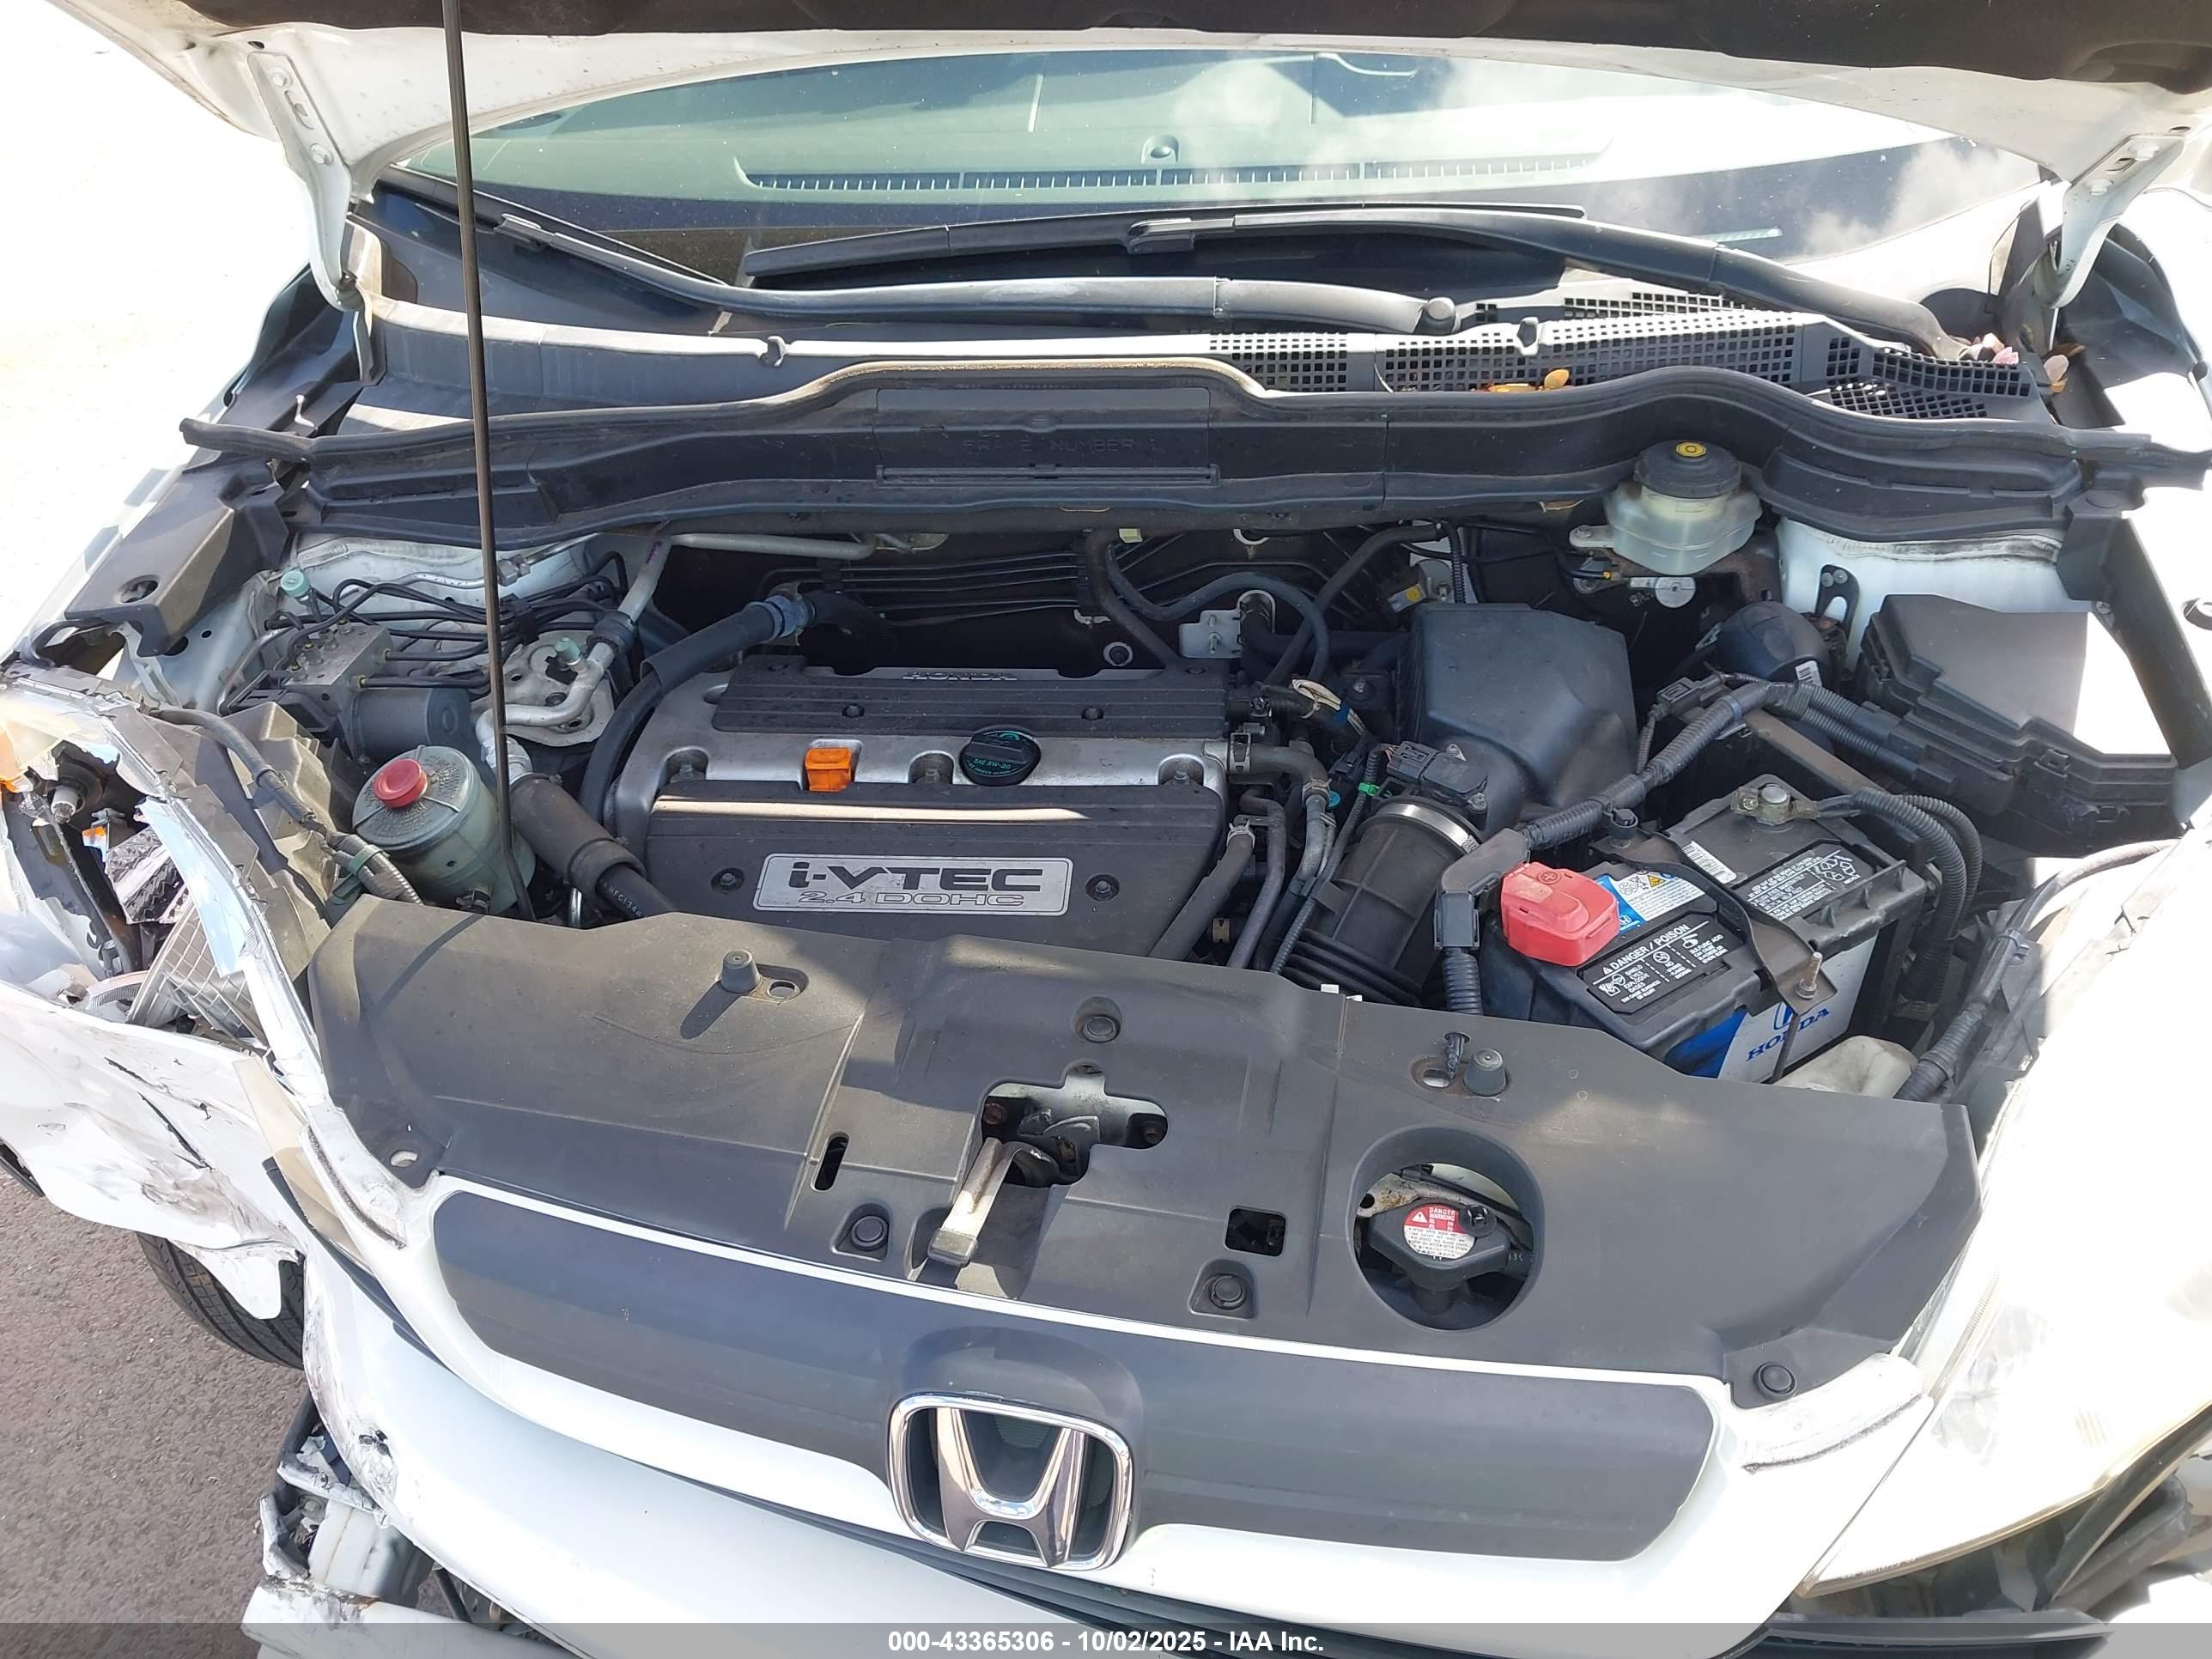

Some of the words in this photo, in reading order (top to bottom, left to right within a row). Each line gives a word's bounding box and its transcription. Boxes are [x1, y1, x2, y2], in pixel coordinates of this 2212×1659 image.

[987, 761, 1012, 769] 5W-20
[788, 861, 1043, 892] i-VTEC
[798, 890, 866, 904] 2.4
[874, 892, 1025, 907] DOHC
[1609, 945, 1650, 970] DANGER
[1653, 923, 1691, 946] POISON
[1429, 1206, 1455, 1217] DANGER
